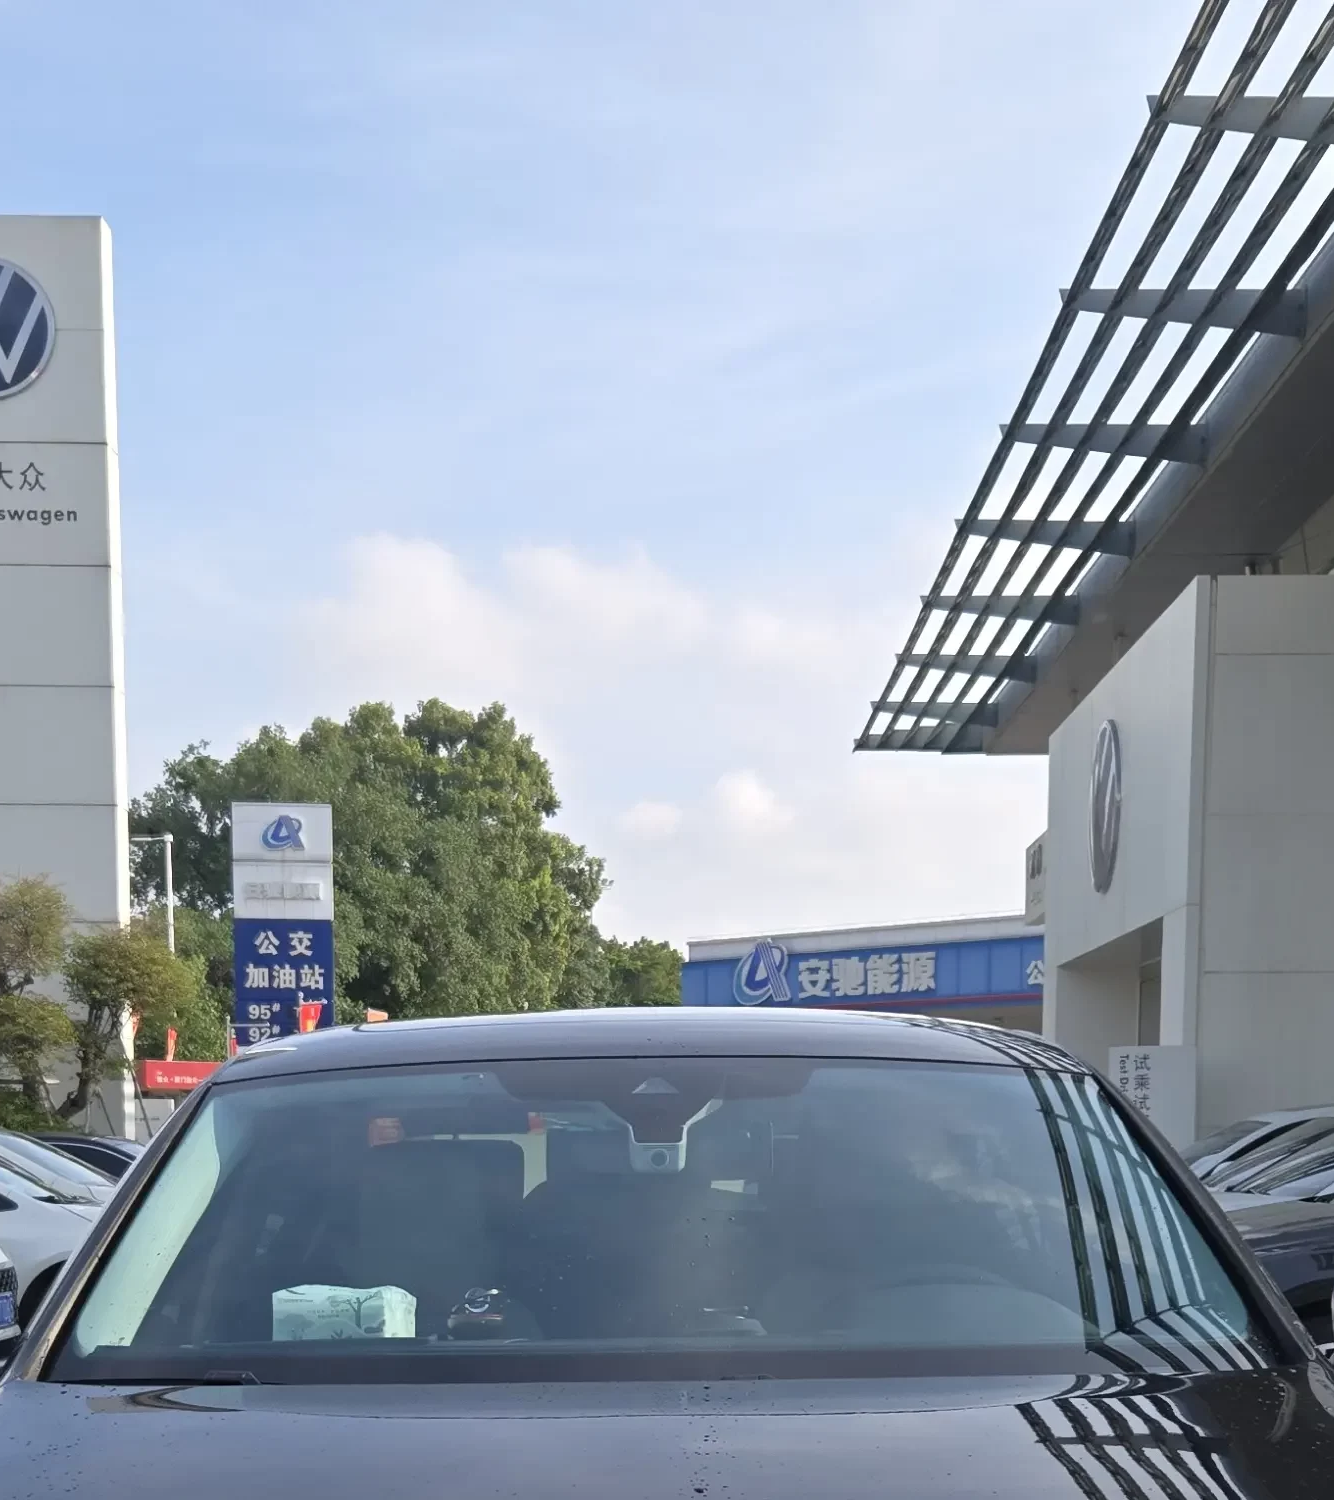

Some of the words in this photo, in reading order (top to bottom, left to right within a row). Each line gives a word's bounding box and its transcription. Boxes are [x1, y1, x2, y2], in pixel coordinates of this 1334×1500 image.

[253, 930, 314, 957] 公交
[244, 963, 325, 990] 加油站
[797, 950, 937, 999] 安驰能源
[248, 1002, 281, 1020] 95#
[1133, 1053, 1151, 1118] 试乘试
